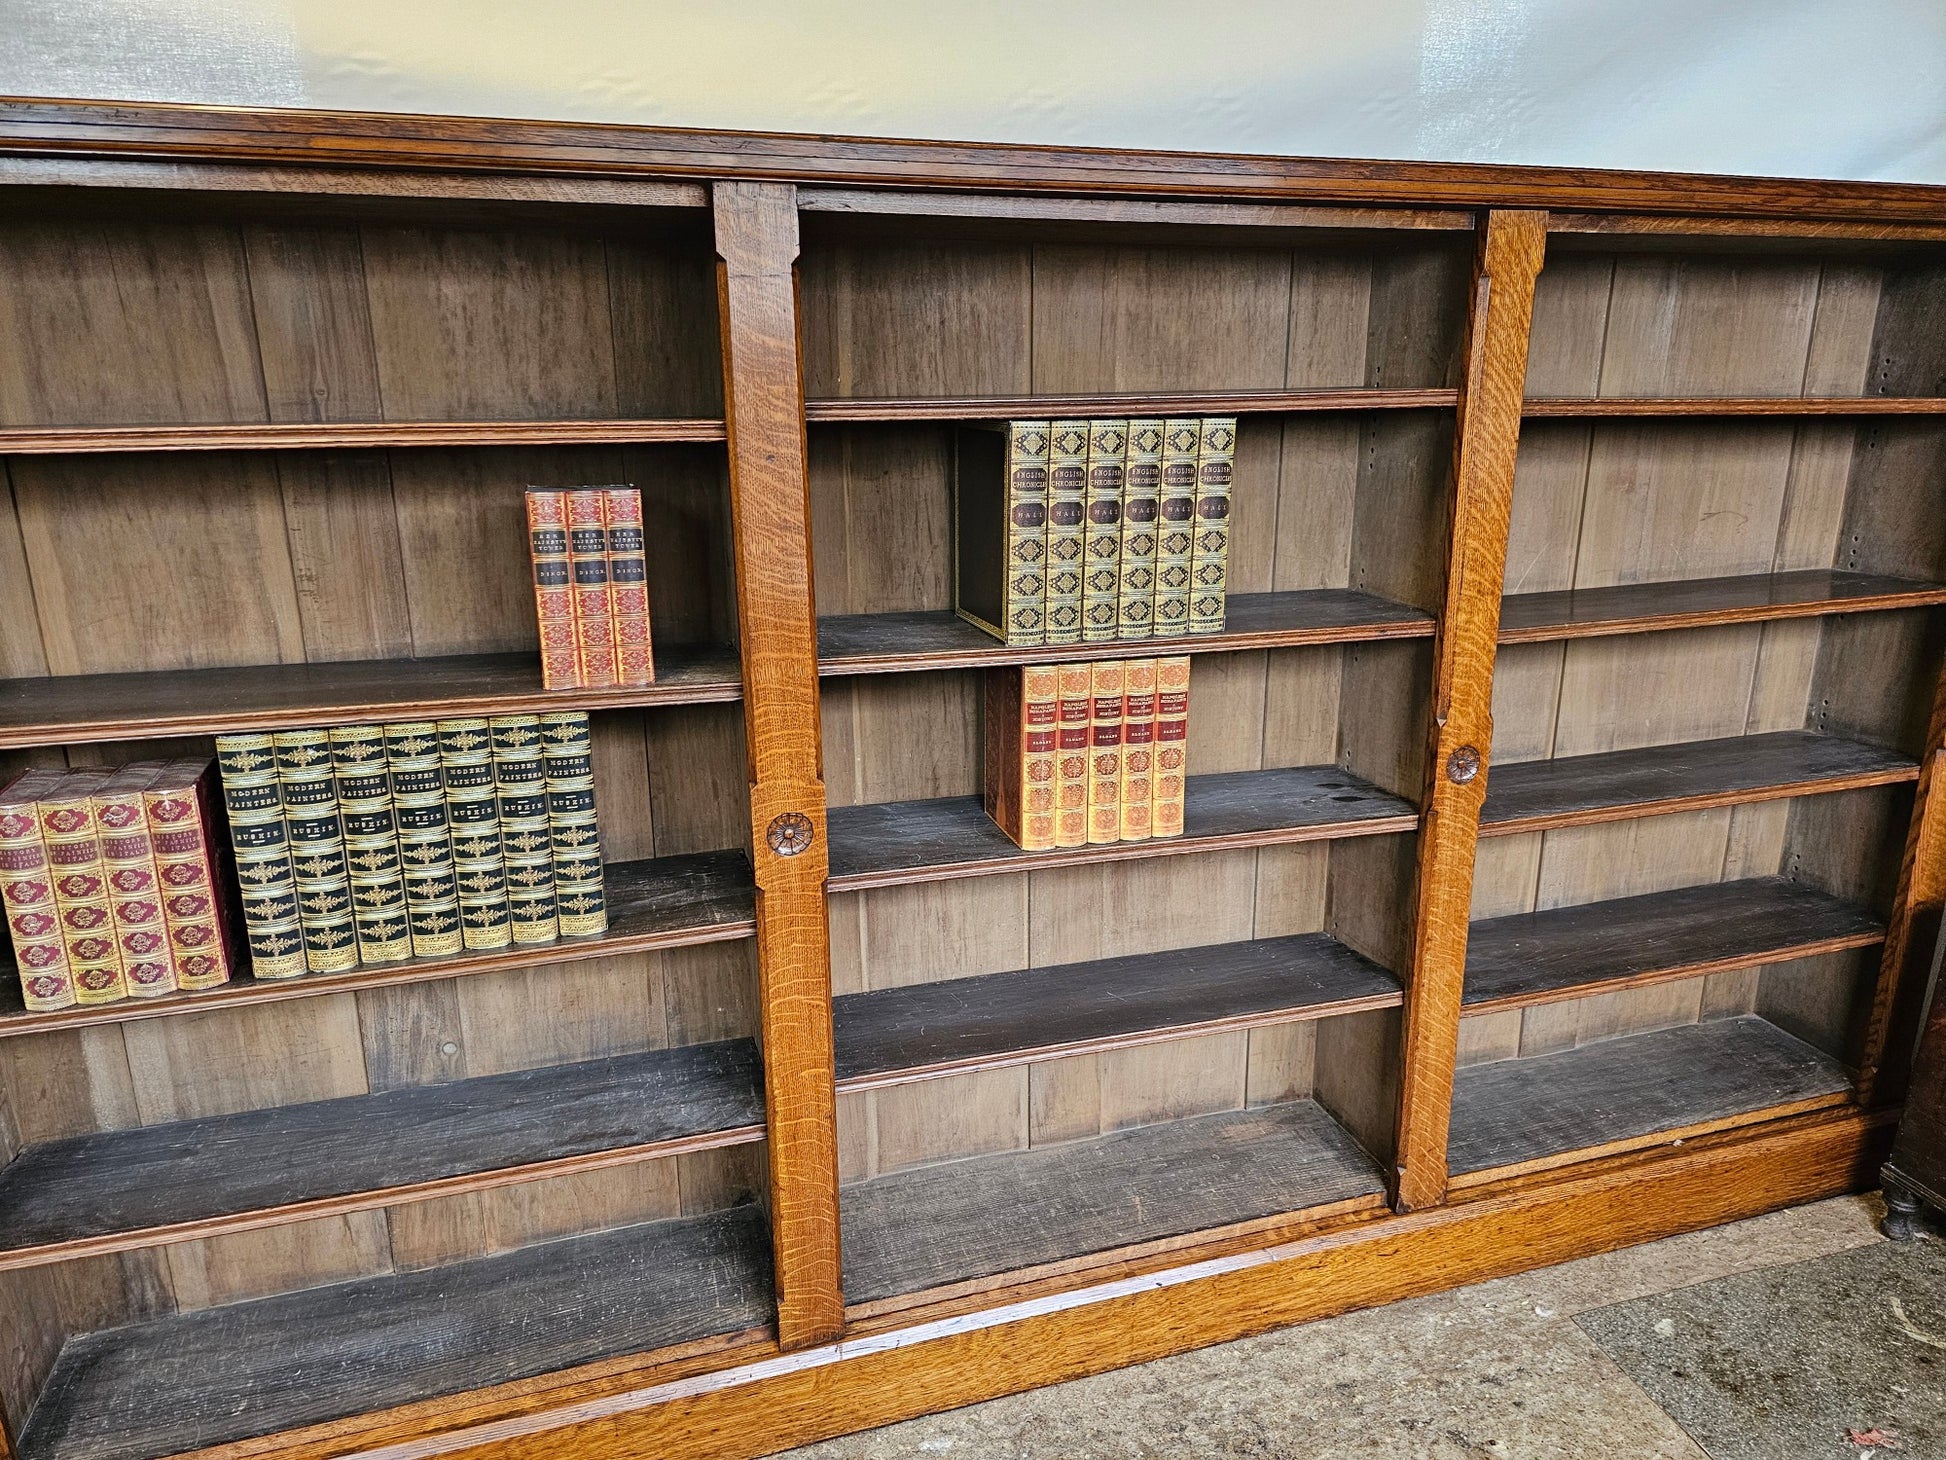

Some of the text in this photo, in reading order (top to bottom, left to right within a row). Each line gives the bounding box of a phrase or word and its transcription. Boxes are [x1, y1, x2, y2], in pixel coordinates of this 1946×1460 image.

[1056, 470, 1083, 478] ENGLISH
[502, 762, 536, 770] MODERN
[551, 758, 584, 766] MODERN
[450, 767, 486, 775] MODERN
[548, 767, 590, 776] PAINTERS
[398, 772, 434, 780] MODERN
[500, 772, 542, 780] PAINTERS
[344, 778, 380, 786] MODERN
[448, 776, 491, 785] PAINTERS
[288, 782, 325, 791] MODERN
[396, 781, 439, 791] PAINTERS
[231, 788, 270, 797] MODERN
[342, 787, 386, 797] PAINTERS
[287, 792, 332, 802] PAINTERS
[230, 797, 277, 808] PAINTERS
[106, 837, 140, 845] HISTORY
[52, 842, 89, 850] HISTORY
